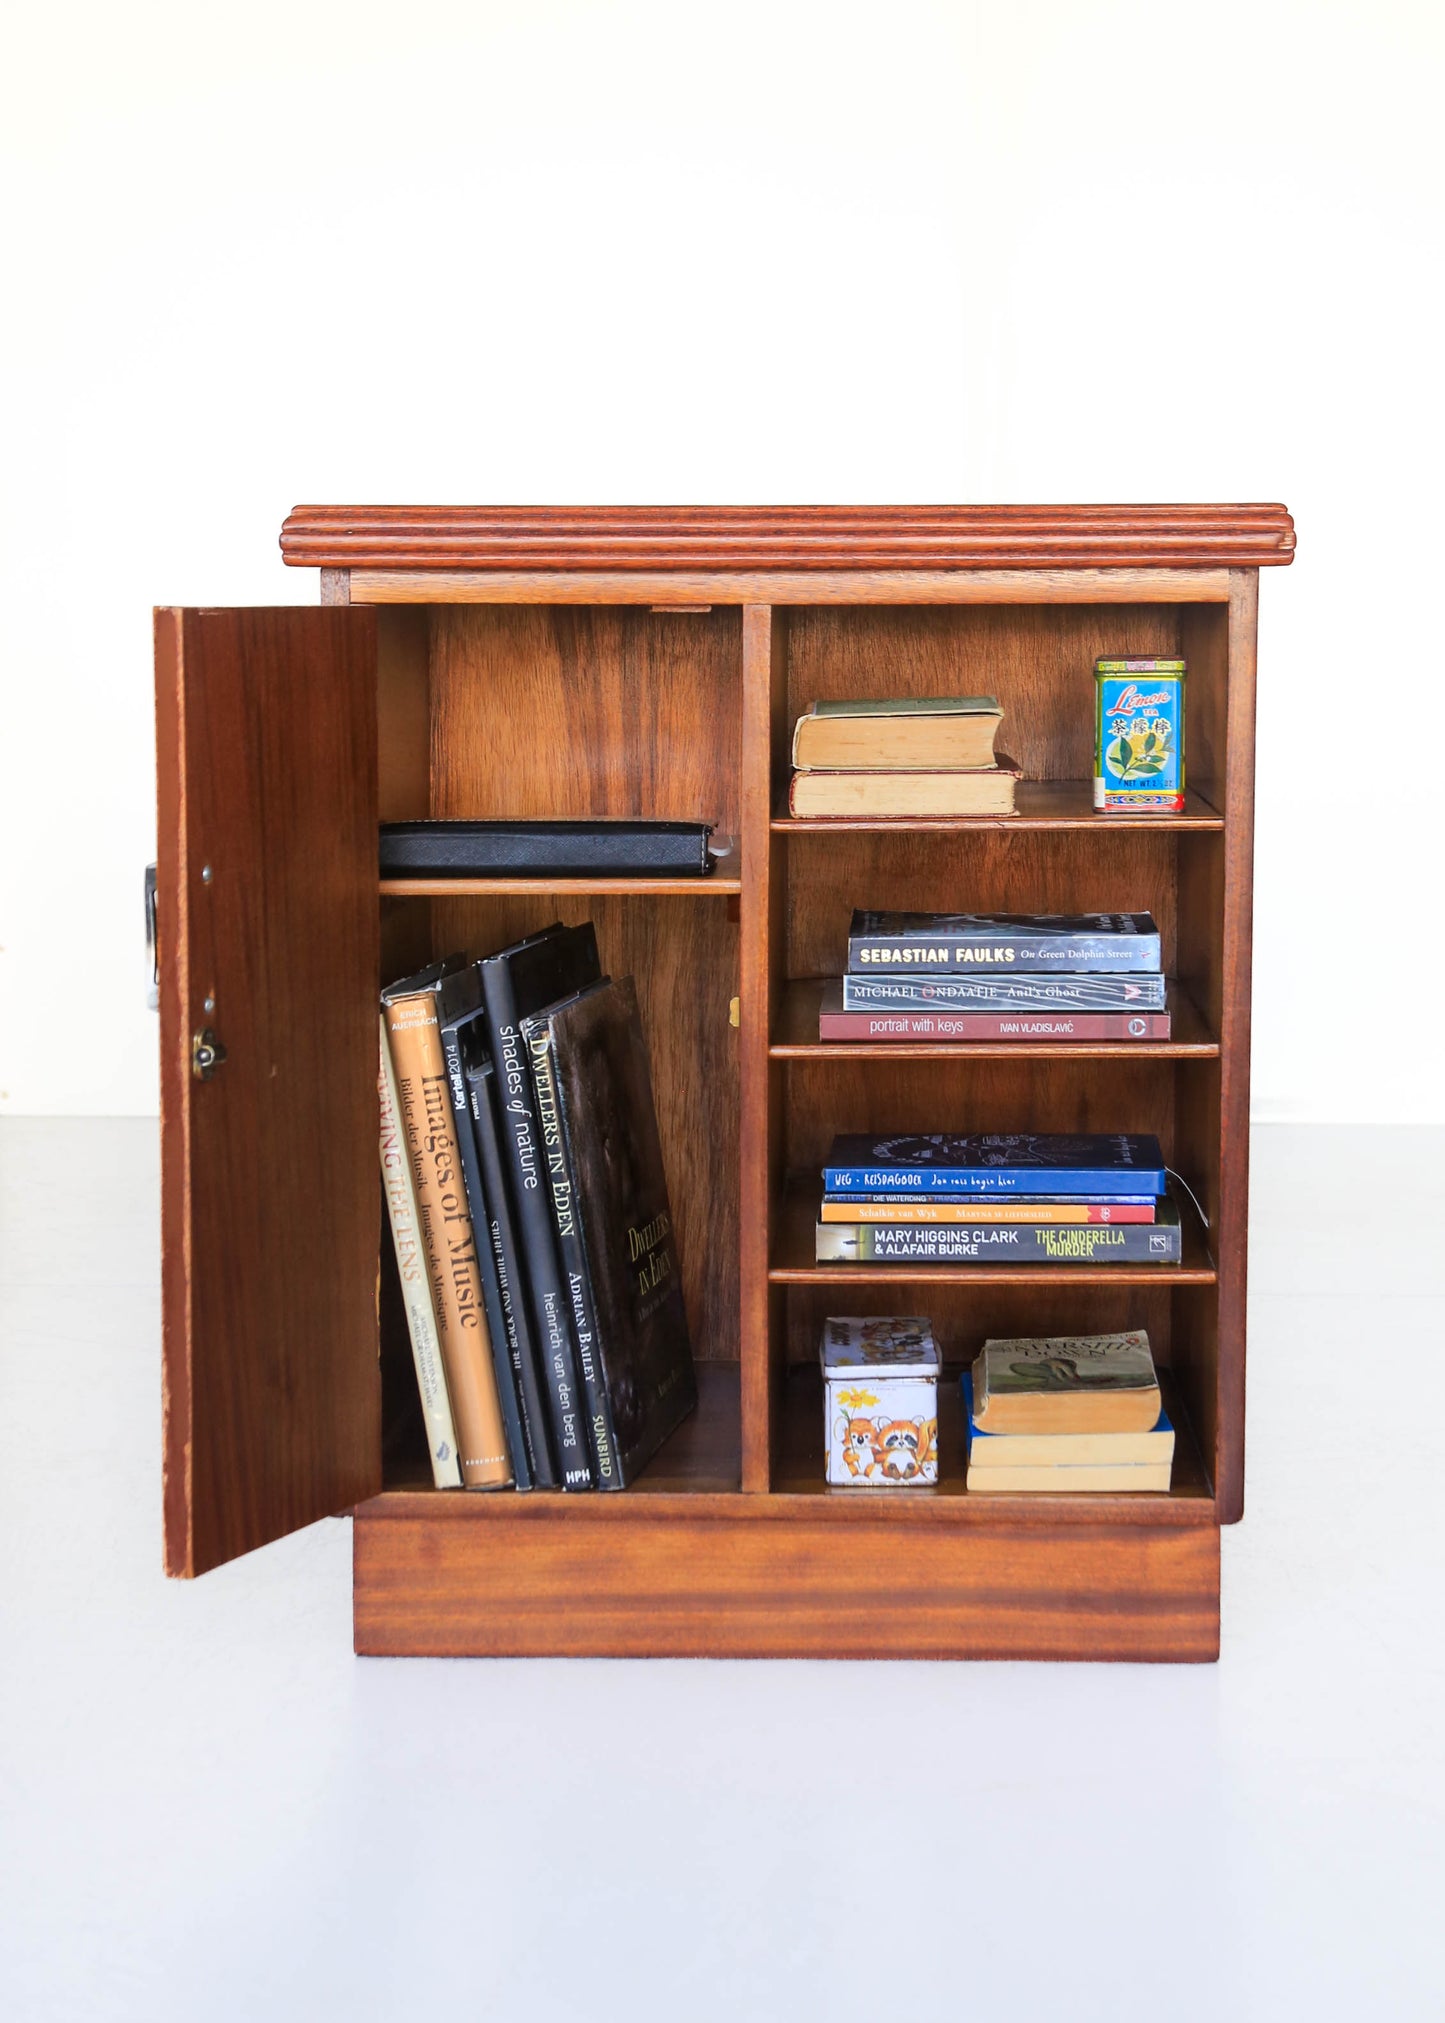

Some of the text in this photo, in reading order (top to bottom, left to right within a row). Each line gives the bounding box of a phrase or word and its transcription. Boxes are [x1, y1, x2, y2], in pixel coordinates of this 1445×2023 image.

[1106, 685, 1170, 715] Lemon
[860, 948, 1132, 963] SEBASTIAN FAULKS On Green Dolphin Street
[853, 985, 1081, 999] MICHAEL ONDAATJE Anil's Ghost
[870, 1018, 908, 1033] portrait
[911, 1018, 934, 1032] with
[937, 1018, 963, 1034] keys
[1000, 1023, 1019, 1032] IVAN
[400, 1078, 415, 1117] Bilder
[408, 1122, 419, 1145] der
[413, 1150, 428, 1189] Musik
[388, 1174, 410, 1218] THE
[421, 1074, 482, 1329] Images of Music
[530, 1038, 595, 1383] DWELLERS IN EDEN ADRIAN BAILEY
[917, 1209, 936, 1219] Wyk
[421, 1204, 435, 1250] Images
[500, 1026, 577, 1448] shades of nature heinrich van den berg
[874, 1231, 1018, 1243] MARY HIGGINS CLARK
[1035, 1230, 1125, 1244] THE CINDERELLA
[397, 1228, 420, 1282] LENS
[875, 1244, 978, 1255] & ALAFAIR BURKE
[1046, 1242, 1094, 1256] MURDER
[430, 1254, 441, 1270] de
[502, 1290, 513, 1313] AND
[505, 1315, 518, 1348] BLACK
[592, 1415, 611, 1478] SUNBIRD
[566, 1468, 590, 1484] HPH
